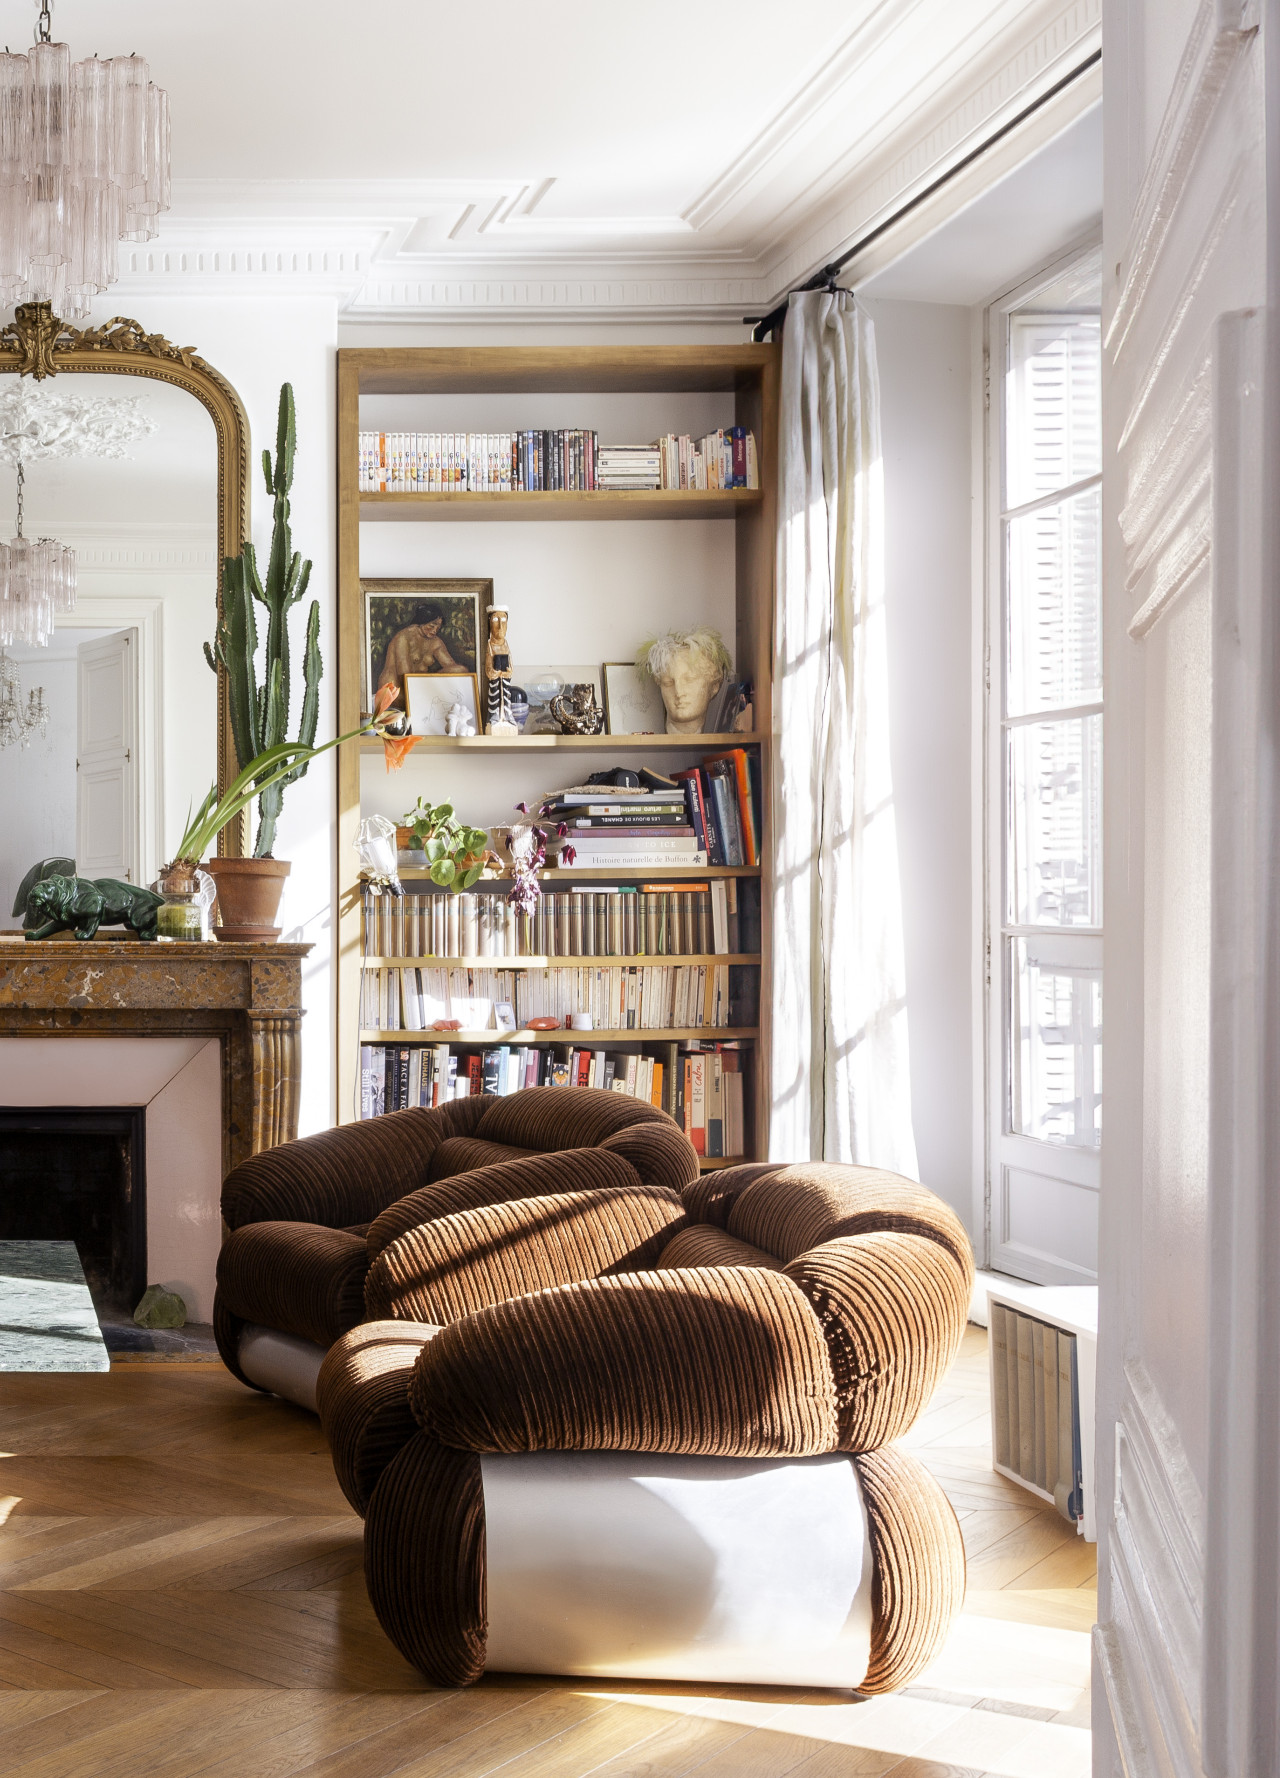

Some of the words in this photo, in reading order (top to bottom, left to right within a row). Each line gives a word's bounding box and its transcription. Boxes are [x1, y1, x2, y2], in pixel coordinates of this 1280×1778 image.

[592, 856, 620, 864] Histoire
[665, 855, 688, 863] Buffon
[361, 1068, 370, 1087] Still
[421, 1051, 429, 1087] BAUHAUS
[471, 1062, 480, 1085] JEAN
[361, 1088, 370, 1112] Lives
